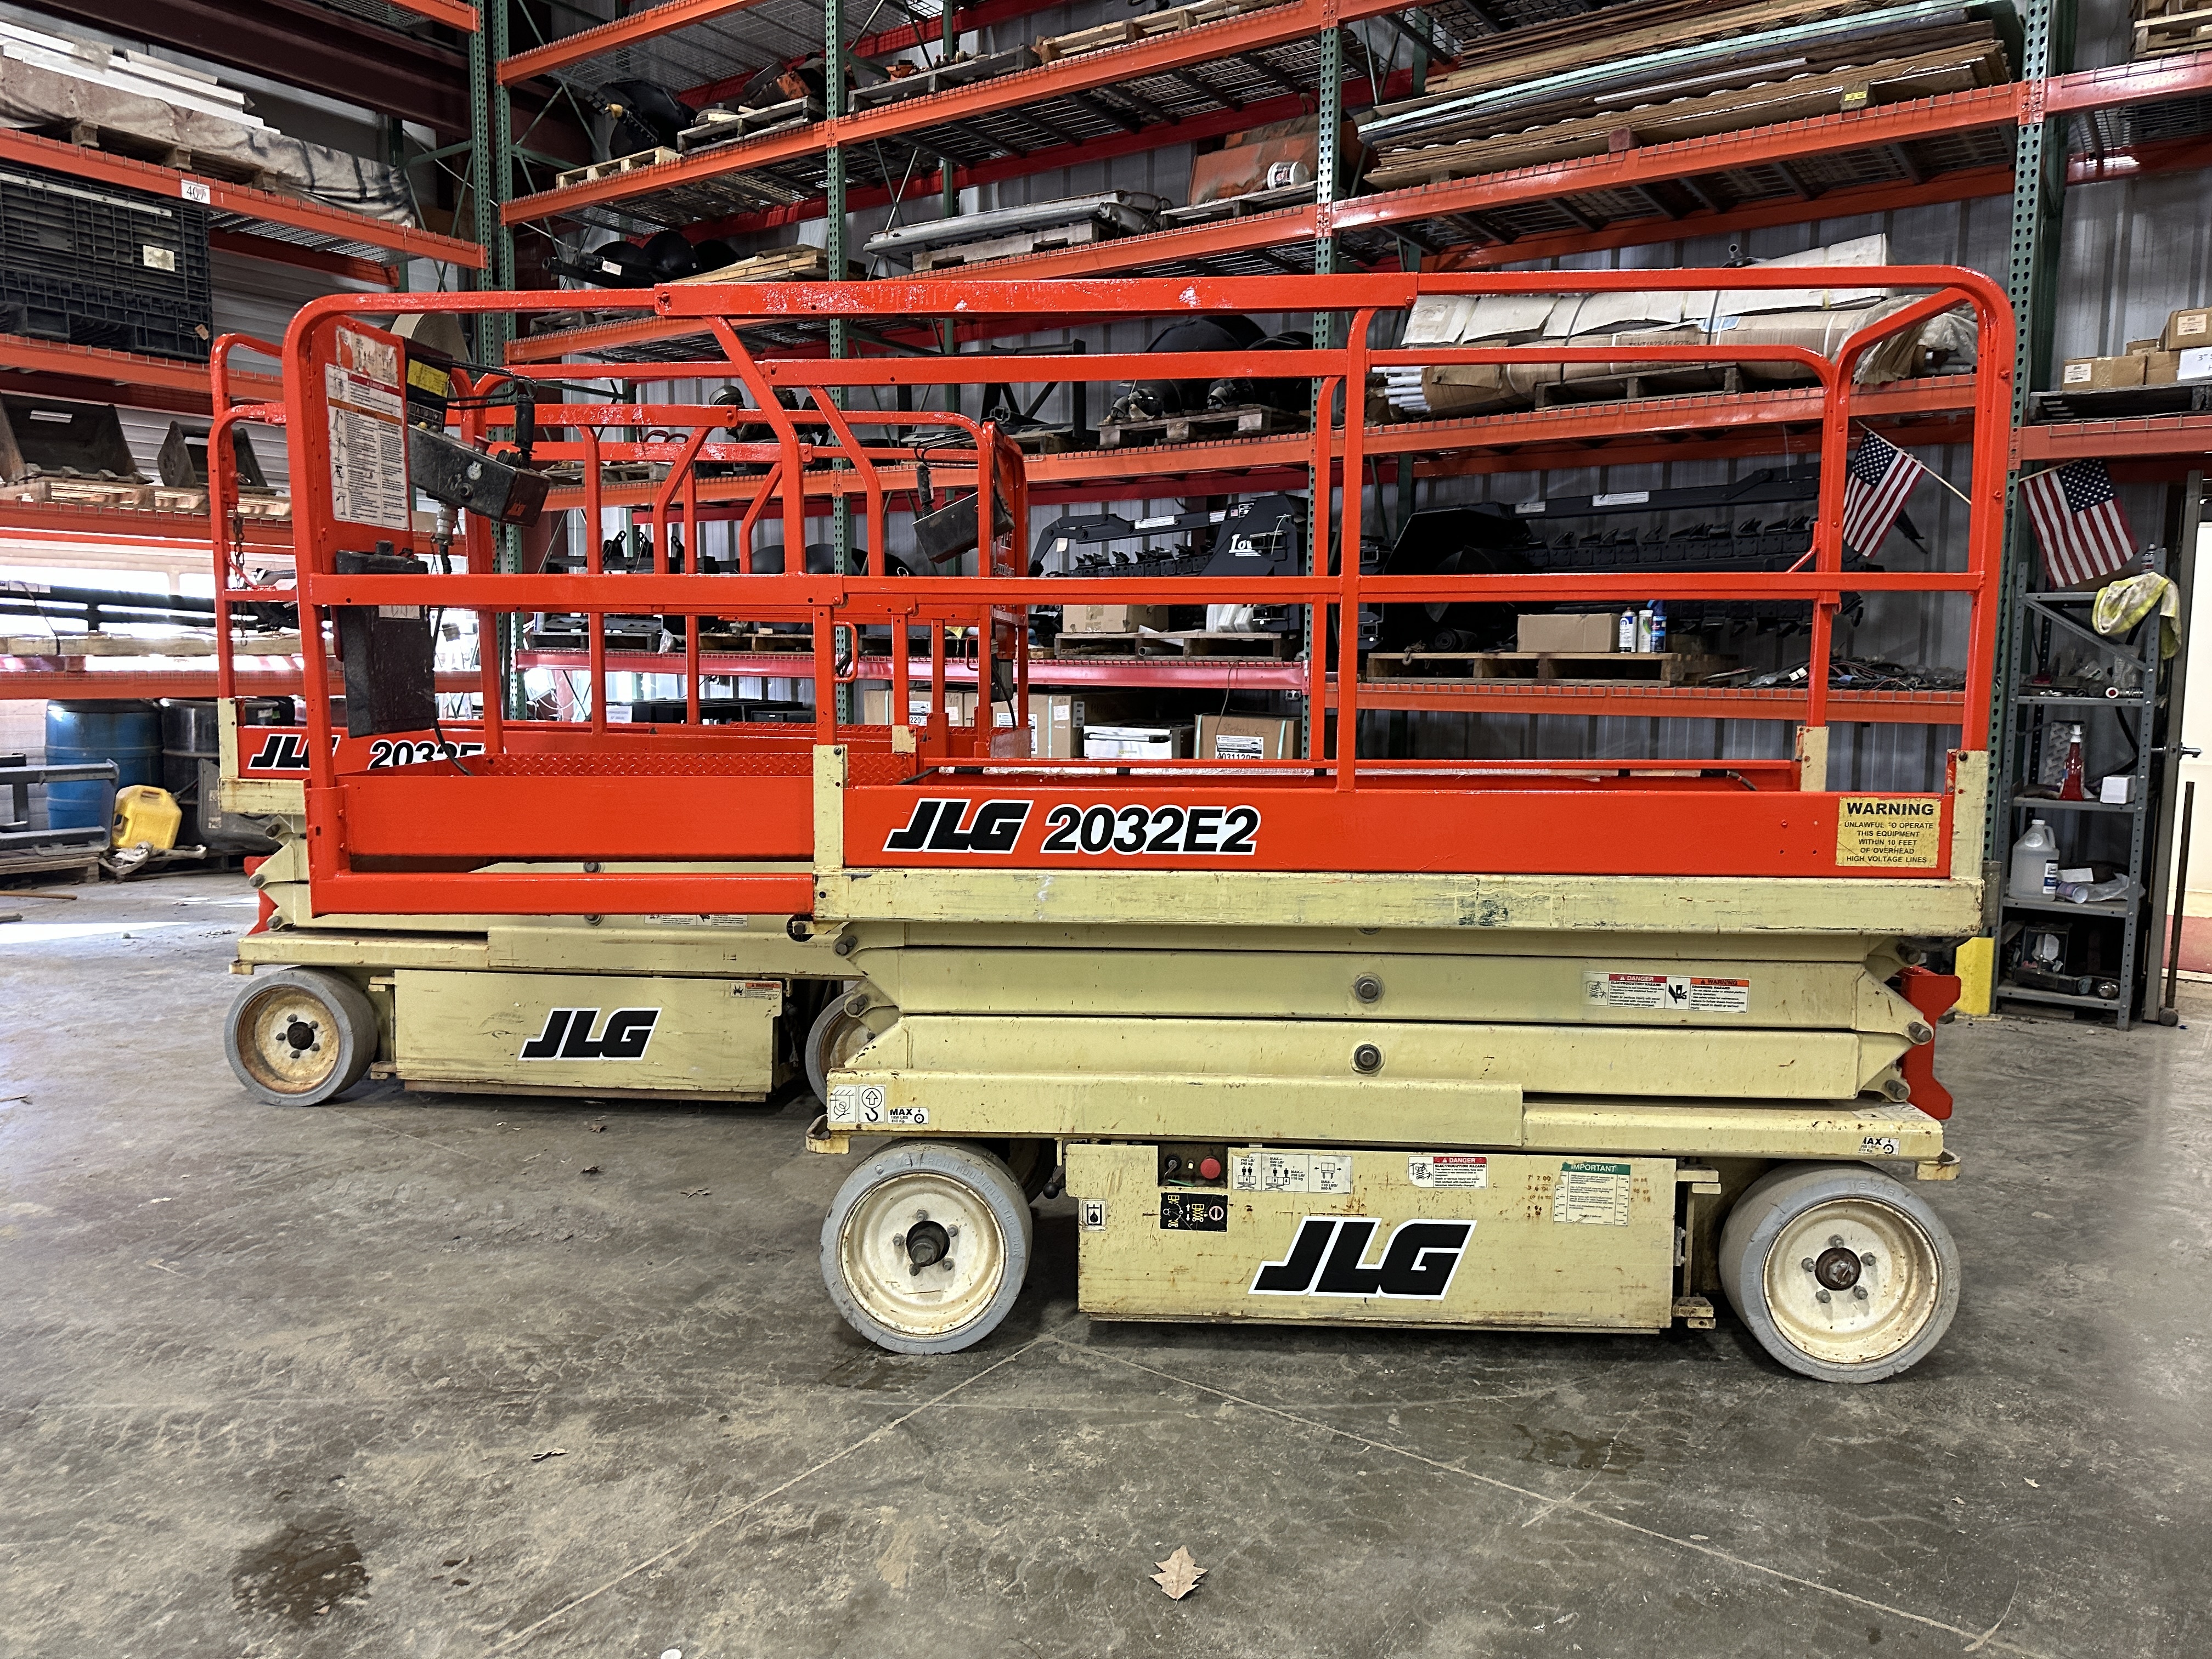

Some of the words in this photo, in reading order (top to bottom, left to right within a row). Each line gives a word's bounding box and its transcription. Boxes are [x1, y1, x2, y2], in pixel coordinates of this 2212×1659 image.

[883, 798, 1034, 853] JLG
[1040, 804, 1261, 855] 2032E2
[1847, 802, 1934, 816] WARNING
[517, 1007, 662, 1060] JLG
[1571, 1163, 1616, 1172] IMPORTANT
[1248, 1216, 1477, 1300] JLG
